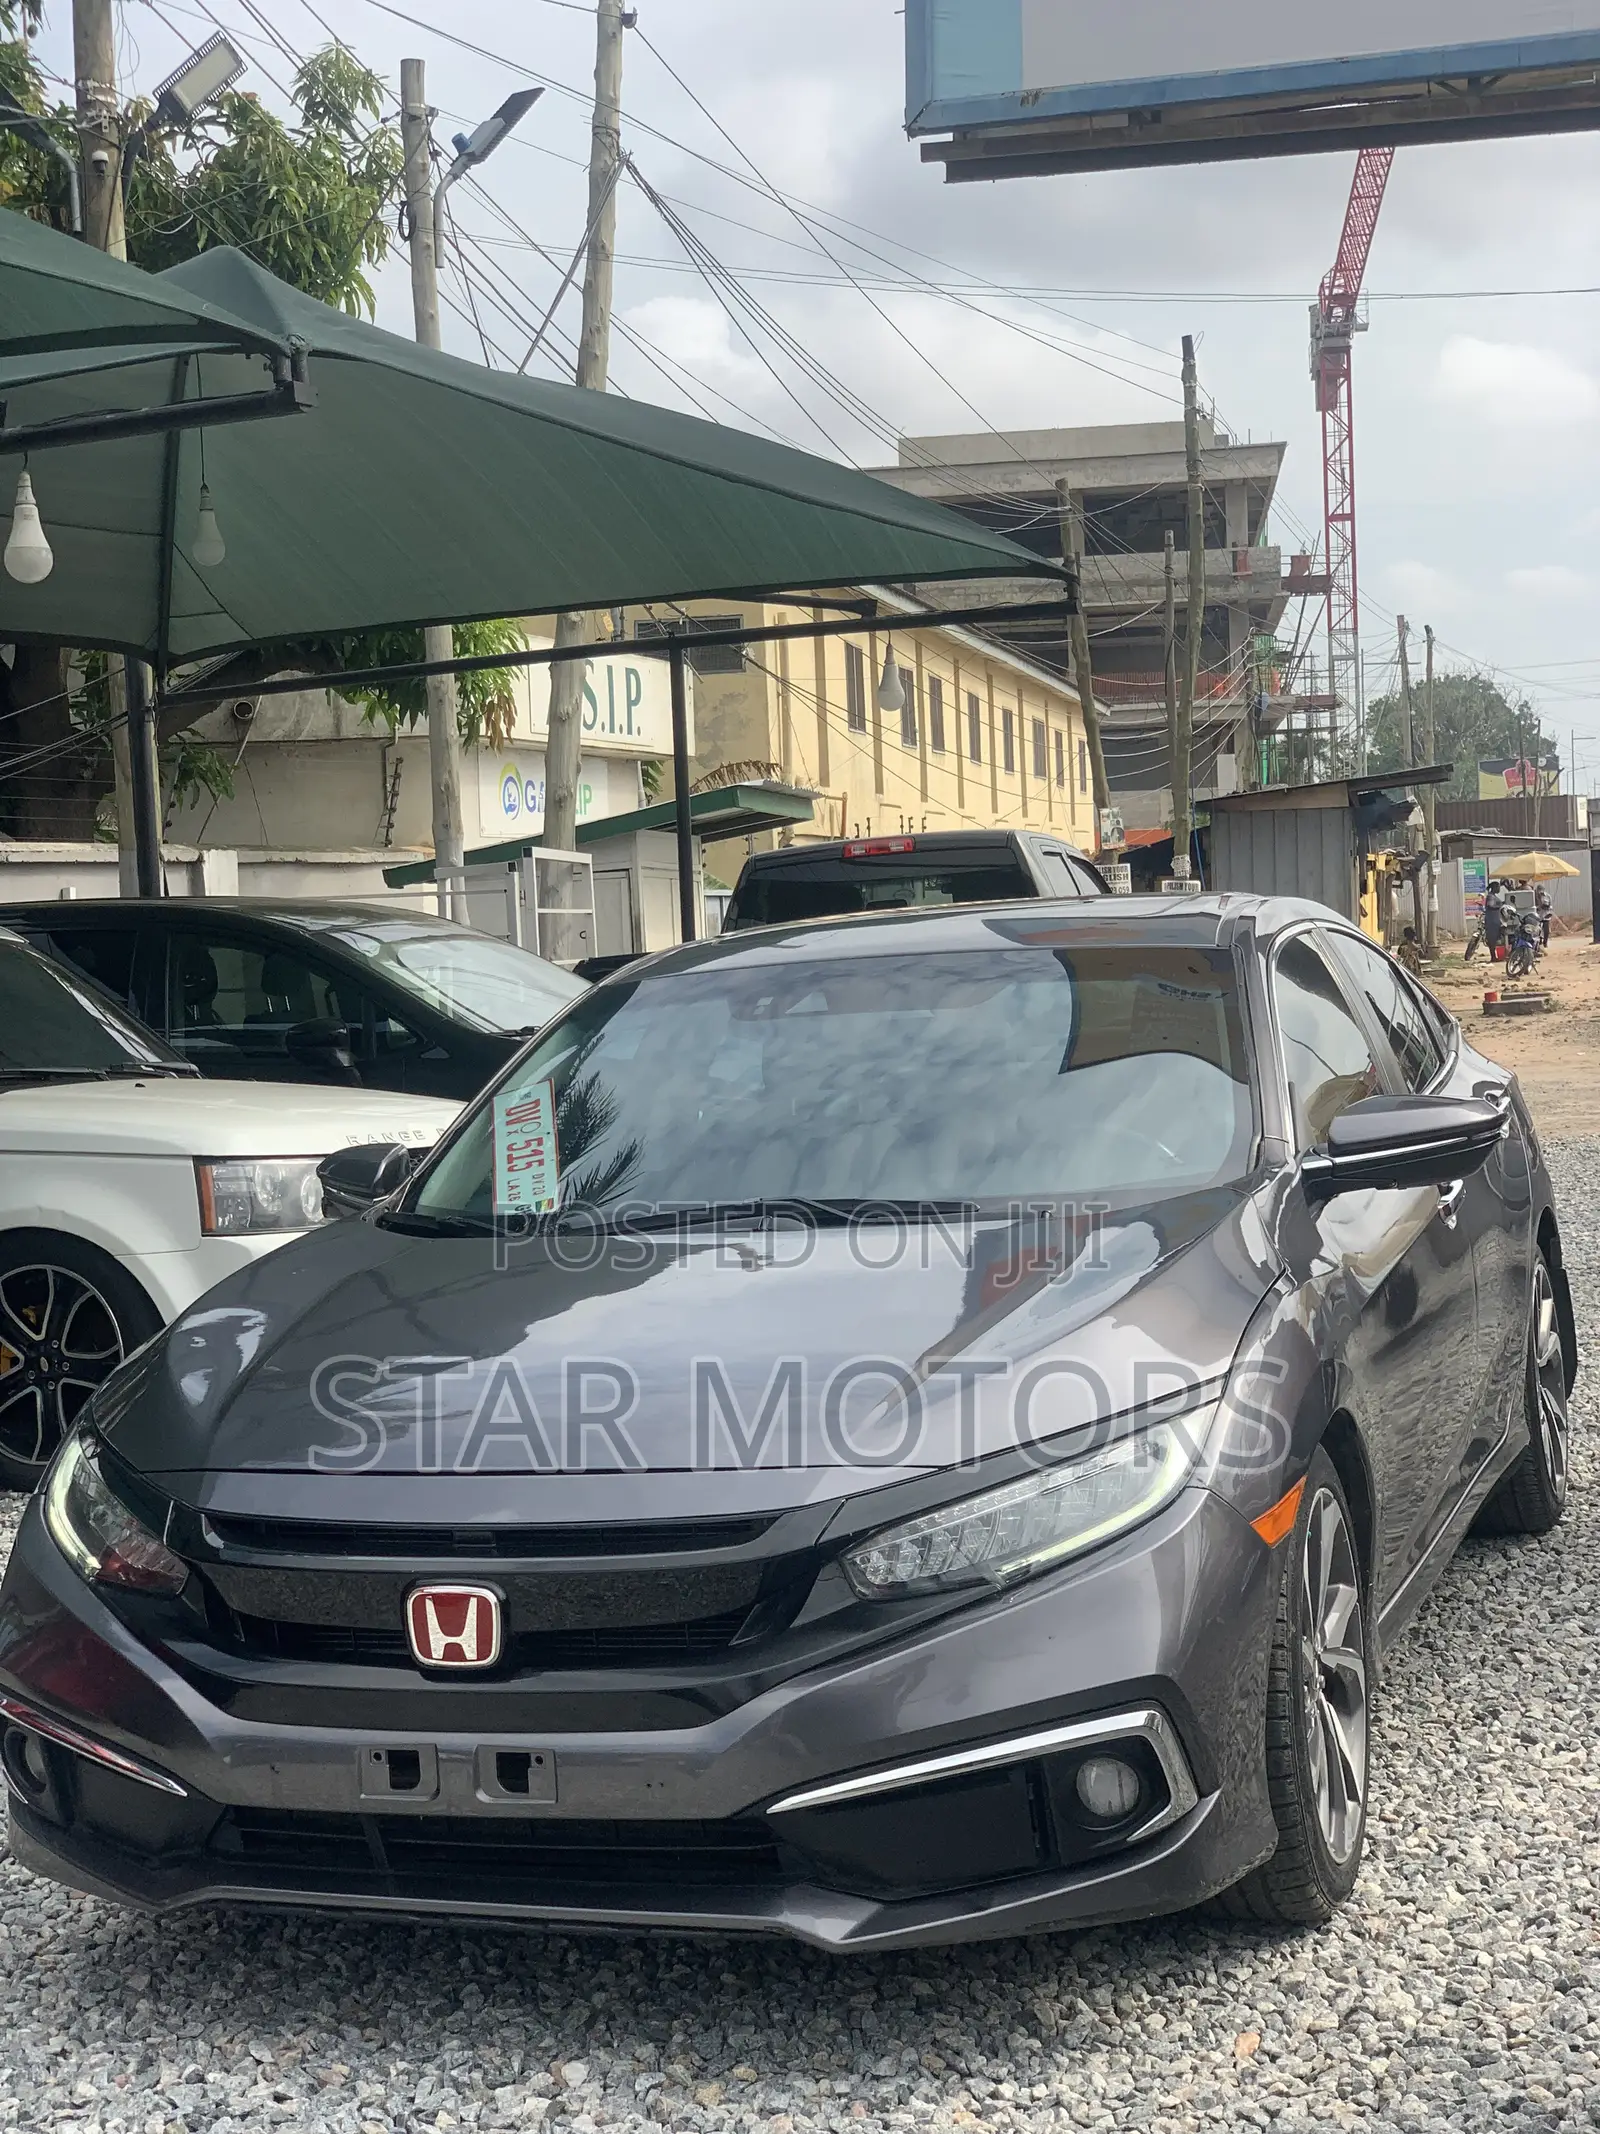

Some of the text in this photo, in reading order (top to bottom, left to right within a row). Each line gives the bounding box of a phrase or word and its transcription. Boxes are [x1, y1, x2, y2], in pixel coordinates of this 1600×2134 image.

[1103, 873, 1129, 881] GLISH
[505, 1098, 542, 1127] DV
[345, 1130, 426, 1146] RANGE
[506, 1136, 545, 1173] 515
[425, 1595, 478, 1660] H
